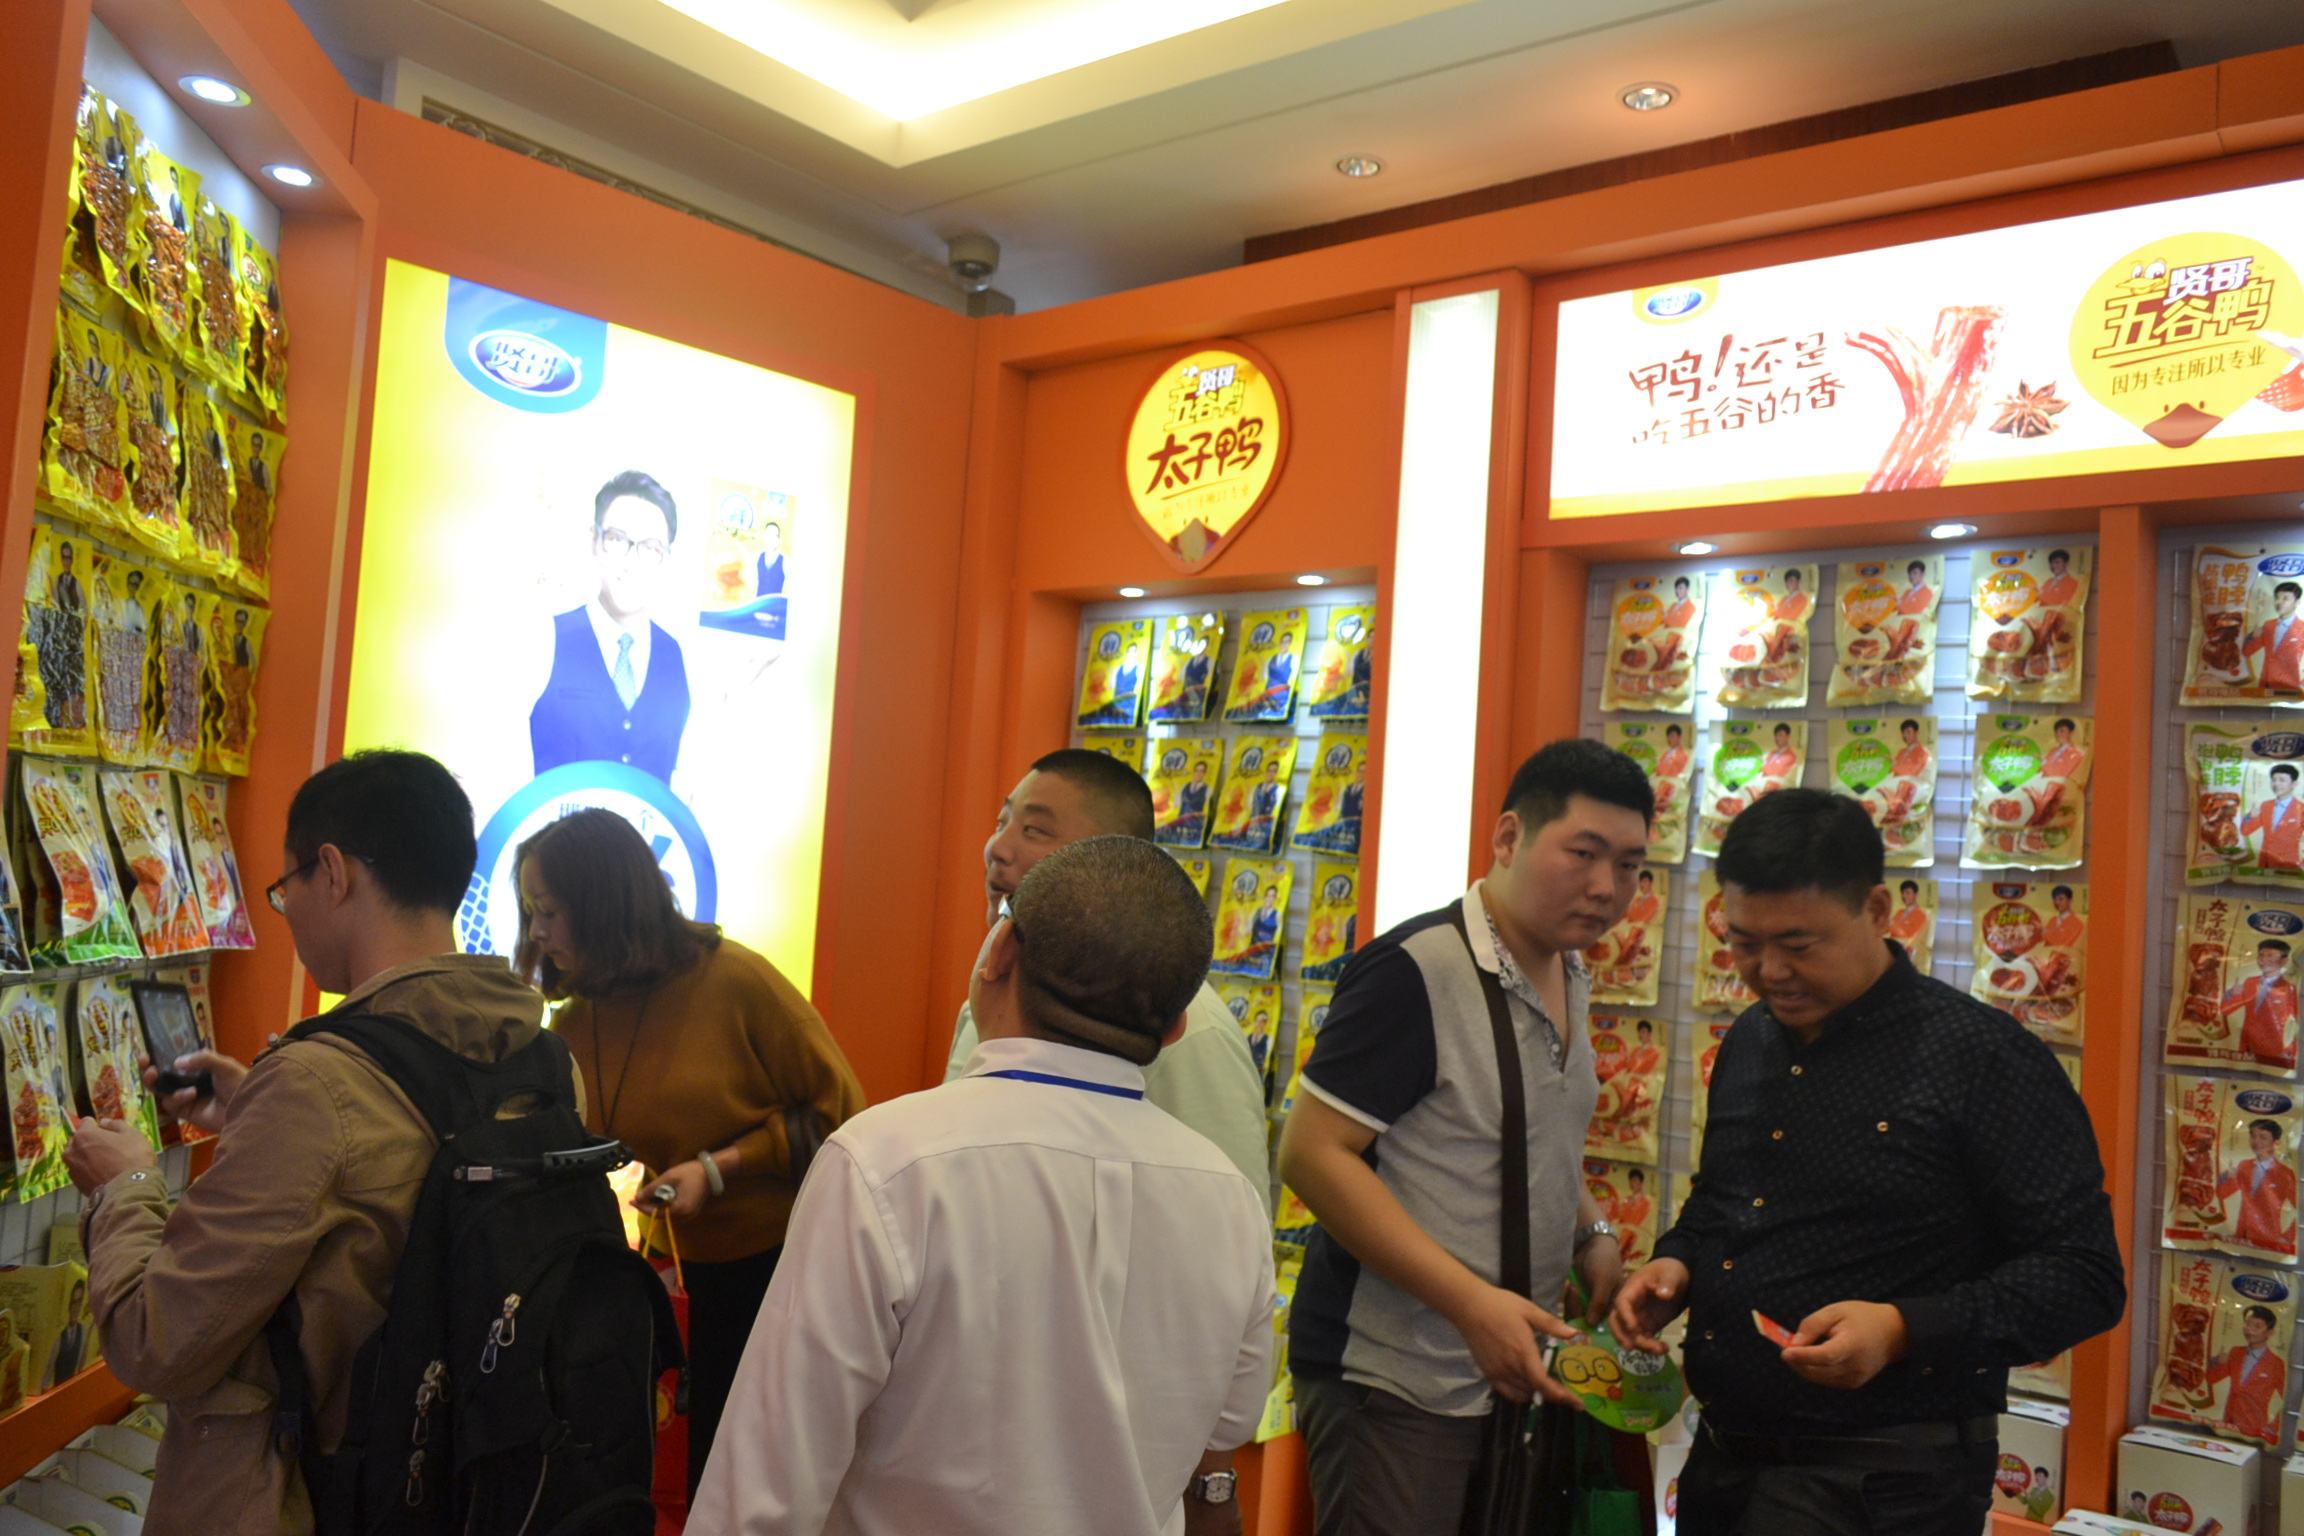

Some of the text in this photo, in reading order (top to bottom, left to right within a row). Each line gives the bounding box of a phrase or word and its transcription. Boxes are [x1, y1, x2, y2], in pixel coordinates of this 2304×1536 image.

[2162, 256, 2254, 306] 贤哥
[2092, 277, 2275, 360] 五谷鸭
[2112, 345, 2267, 396] 因为专注所以专业
[1632, 372, 1846, 444] 吃五谷的香
[1145, 416, 1263, 495] 太子鸭
